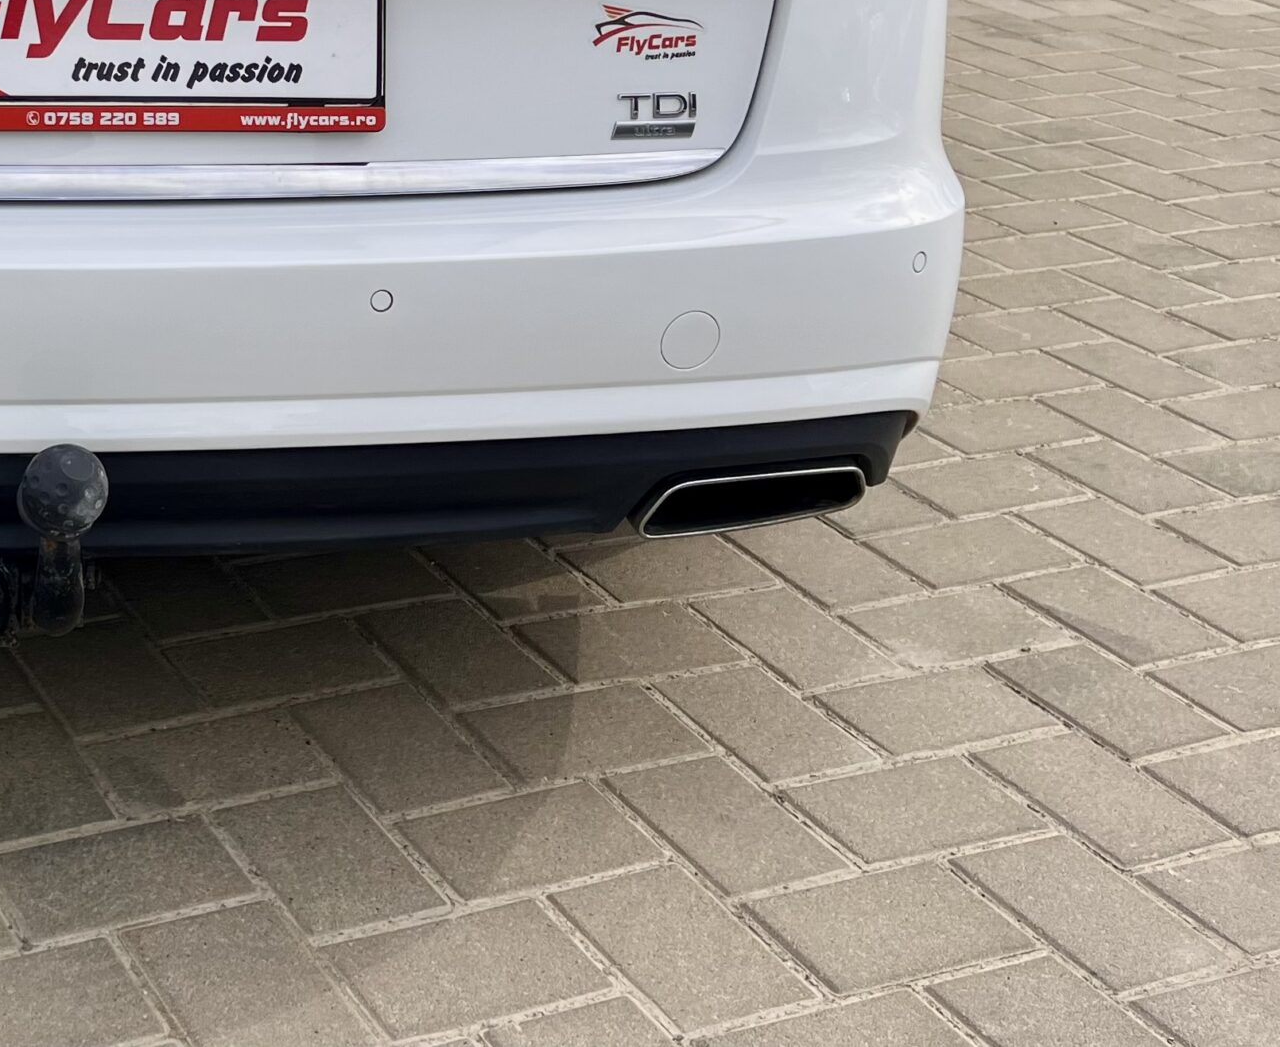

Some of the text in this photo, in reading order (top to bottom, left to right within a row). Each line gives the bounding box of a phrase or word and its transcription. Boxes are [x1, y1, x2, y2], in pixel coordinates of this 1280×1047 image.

[616, 34, 697, 55] FlyCars
[71, 55, 304, 90] trust in passion
[617, 91, 697, 120] TDI
[44, 112, 94, 126] 0758
[99, 112, 137, 126] 220
[143, 112, 180, 126] 589
[240, 112, 377, 130] www.flycars.ro
